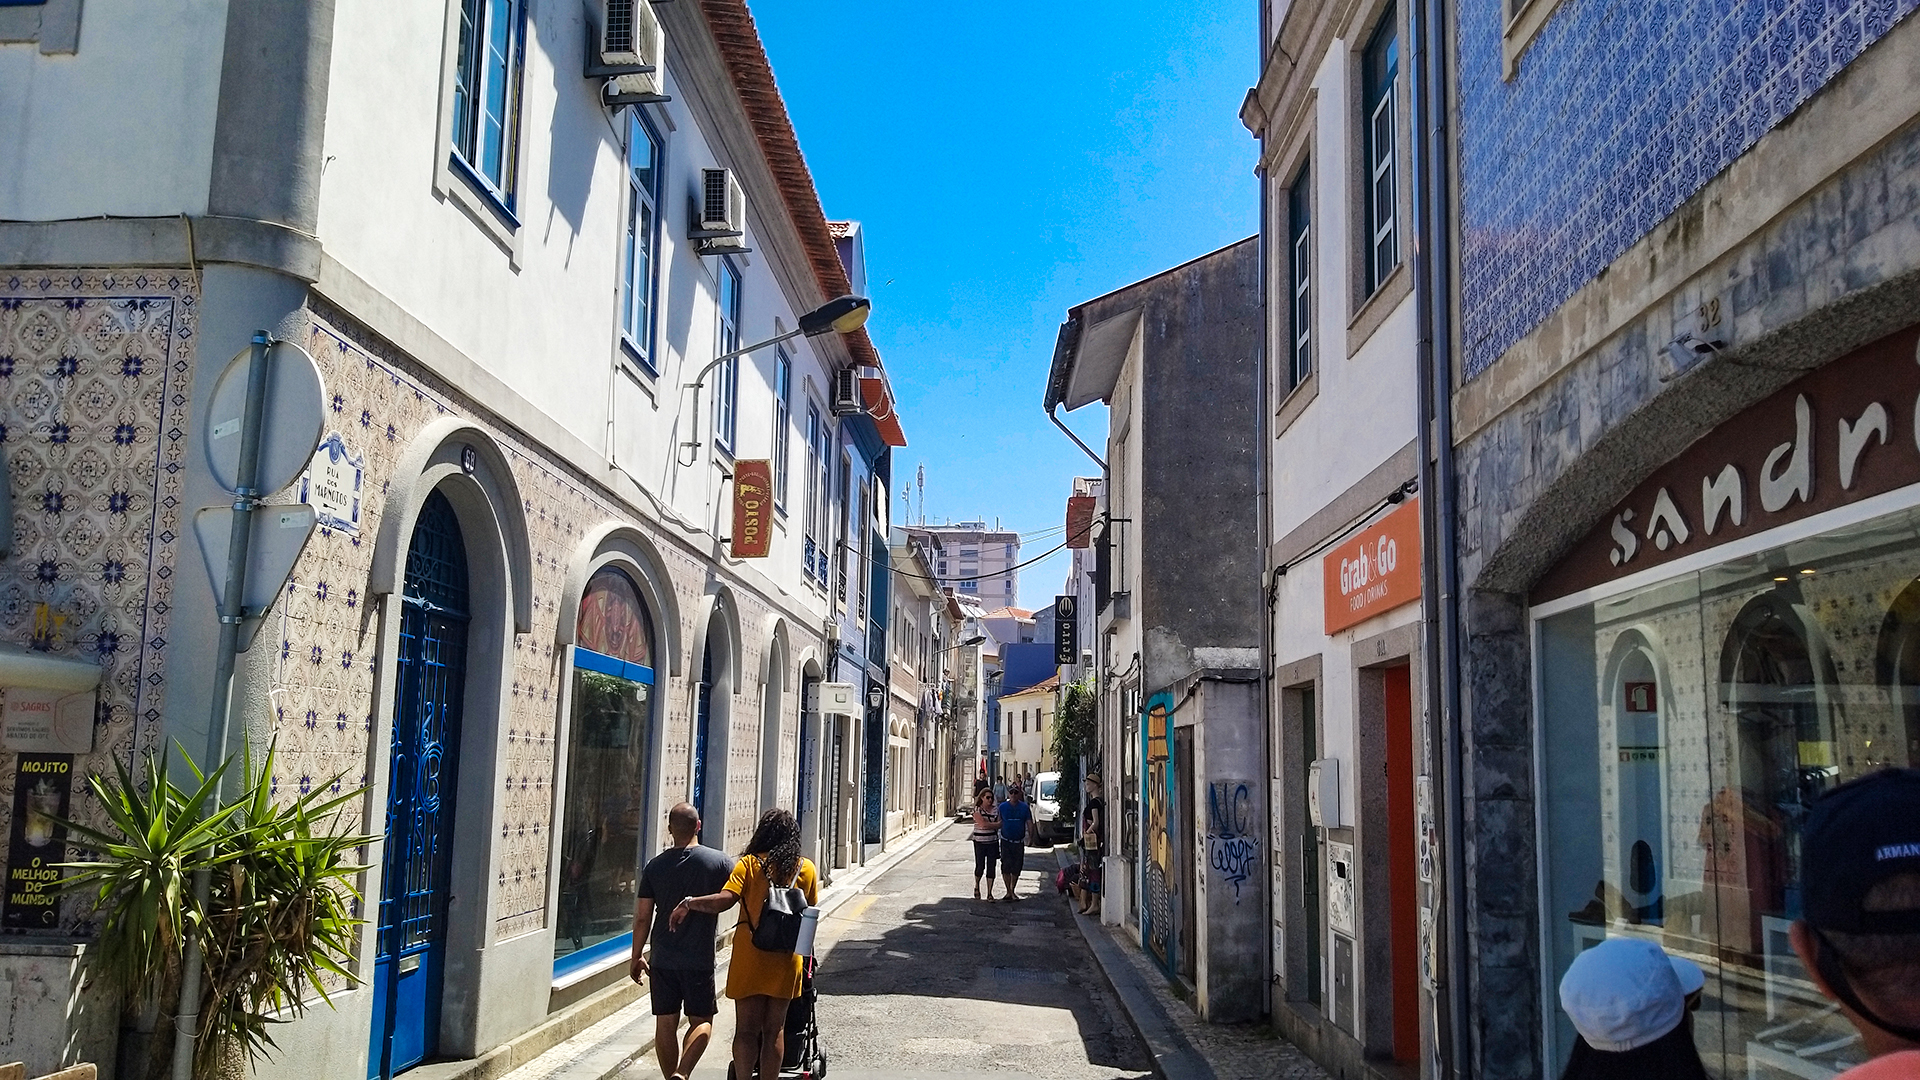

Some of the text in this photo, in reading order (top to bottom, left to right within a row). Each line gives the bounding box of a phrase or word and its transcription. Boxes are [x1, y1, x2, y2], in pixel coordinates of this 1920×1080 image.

[1700, 297, 1722, 333] 32
[326, 466, 339, 479] RUA
[314, 483, 348, 507] MARNOTOS
[744, 500, 759, 545] POSTO
[1059, 622, 1073, 664] Ferro
[20, 701, 51, 712] SAGRES
[31, 857, 41, 868] O
[12, 868, 58, 881] MELHOR
[25, 881, 43, 893] DO
[11, 893, 55, 906] MUNDO
